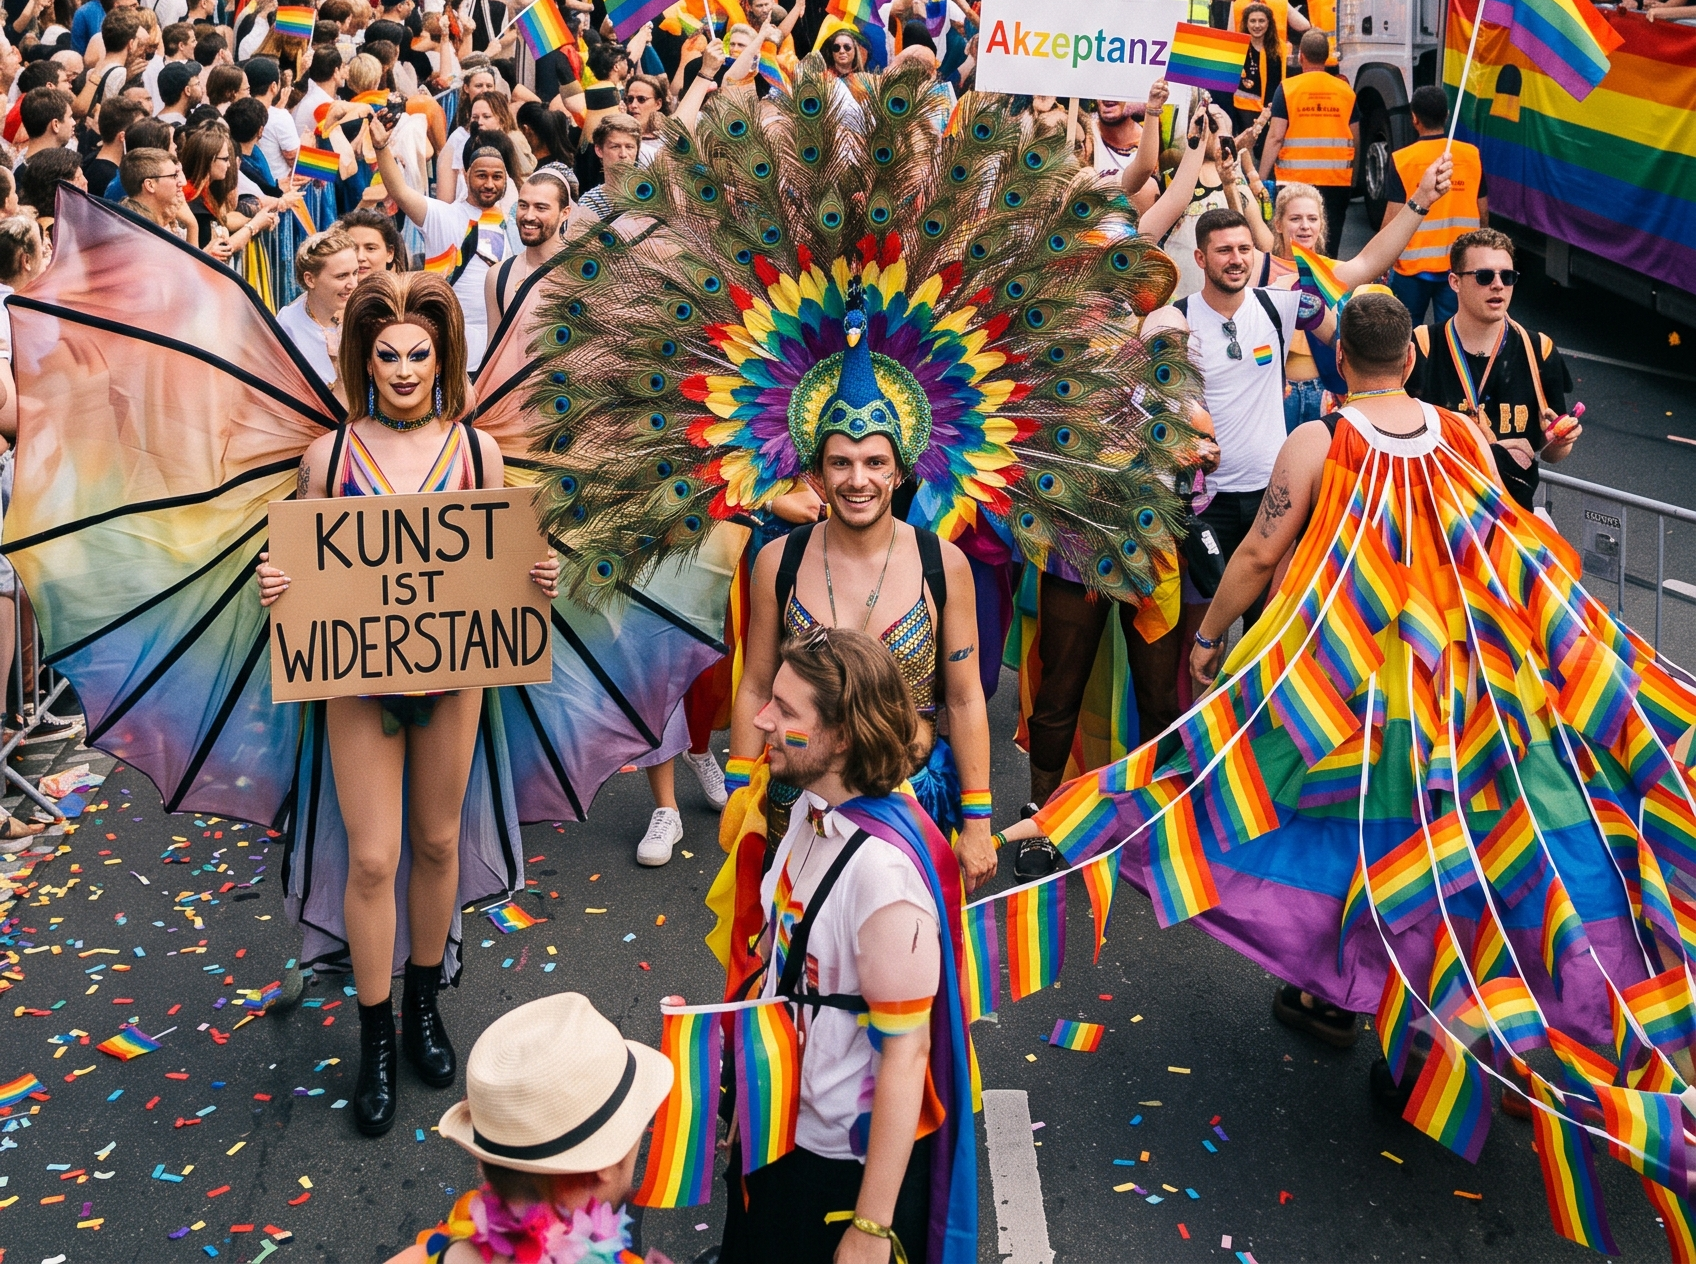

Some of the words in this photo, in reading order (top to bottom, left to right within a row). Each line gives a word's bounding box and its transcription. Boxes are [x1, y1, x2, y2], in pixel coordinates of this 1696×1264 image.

[985, 19, 1168, 69] Akzeptanz
[316, 501, 510, 571] KUNST
[381, 570, 445, 606] IST
[275, 606, 548, 683] WIDERSTAND
